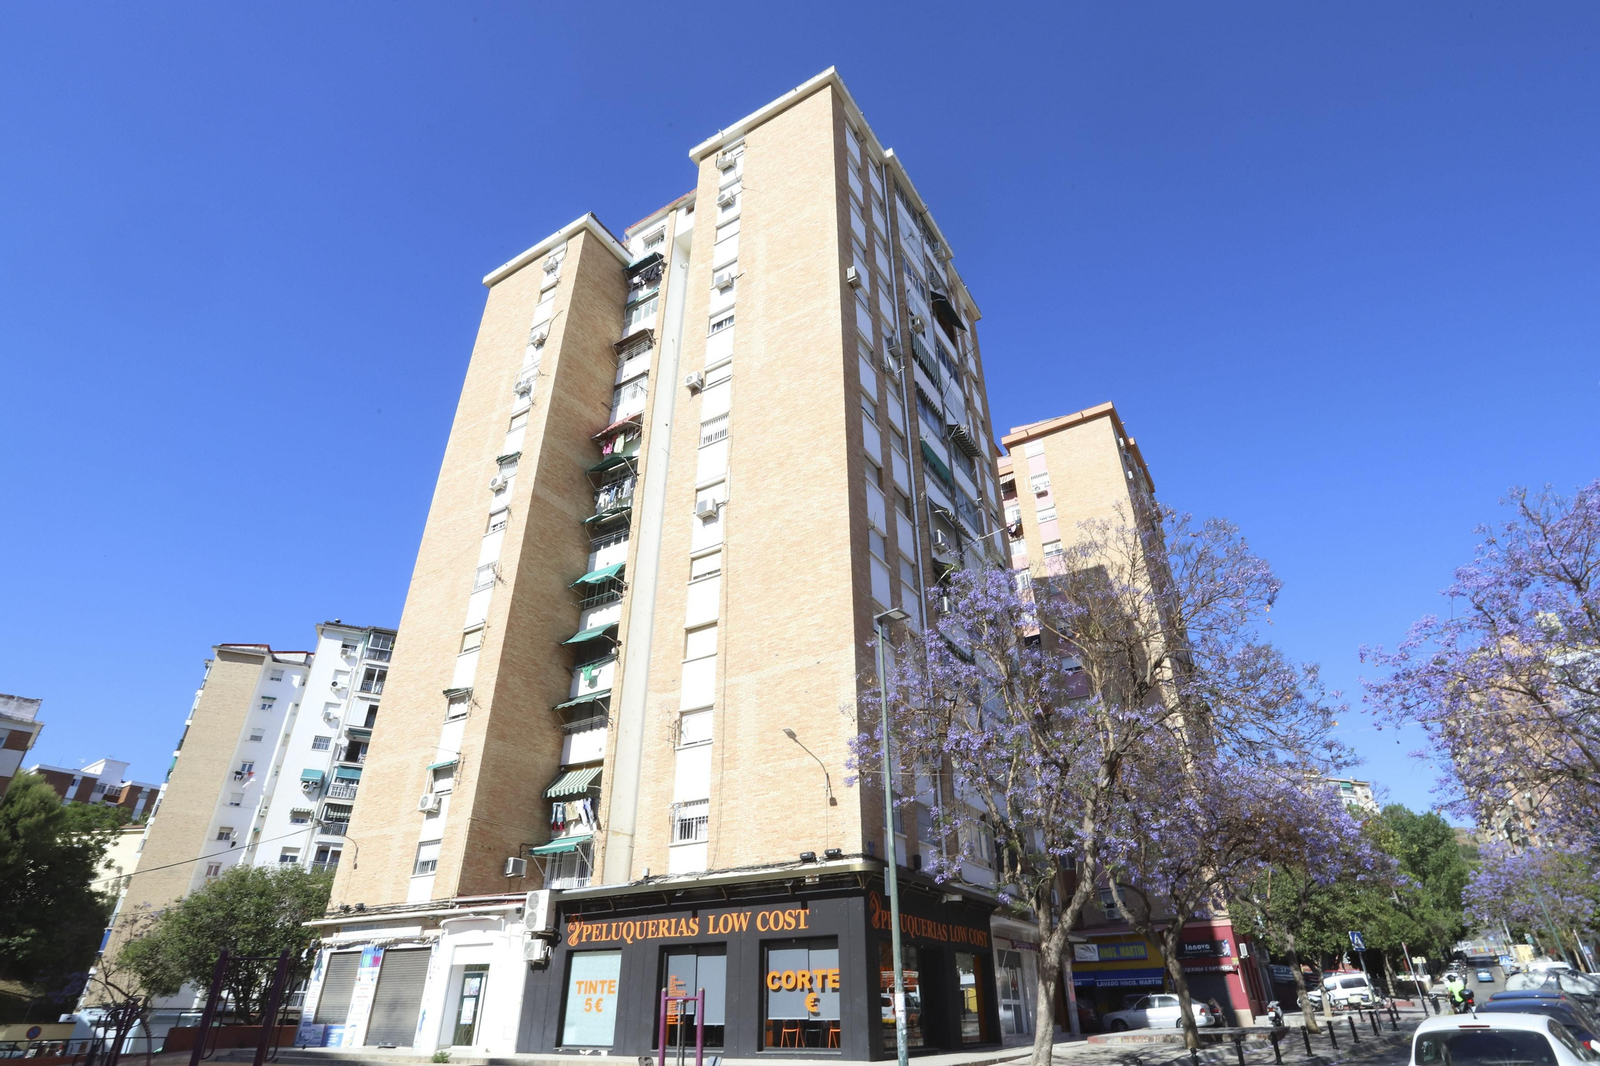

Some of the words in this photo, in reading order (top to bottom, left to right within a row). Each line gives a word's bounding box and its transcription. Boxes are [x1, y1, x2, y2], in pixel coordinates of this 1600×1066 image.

[580, 916, 699, 944] PELUQUERIAS
[707, 911, 752, 935] LOW
[756, 908, 810, 932] COST
[880, 909, 948, 942] PEUQUERIAS
[949, 924, 969, 943] LOW
[968, 928, 988, 947] COST
[1119, 944, 1146, 957] MARTIN
[575, 979, 617, 995] TINTE
[766, 968, 840, 990] CORTE
[804, 992, 818, 1013] €
